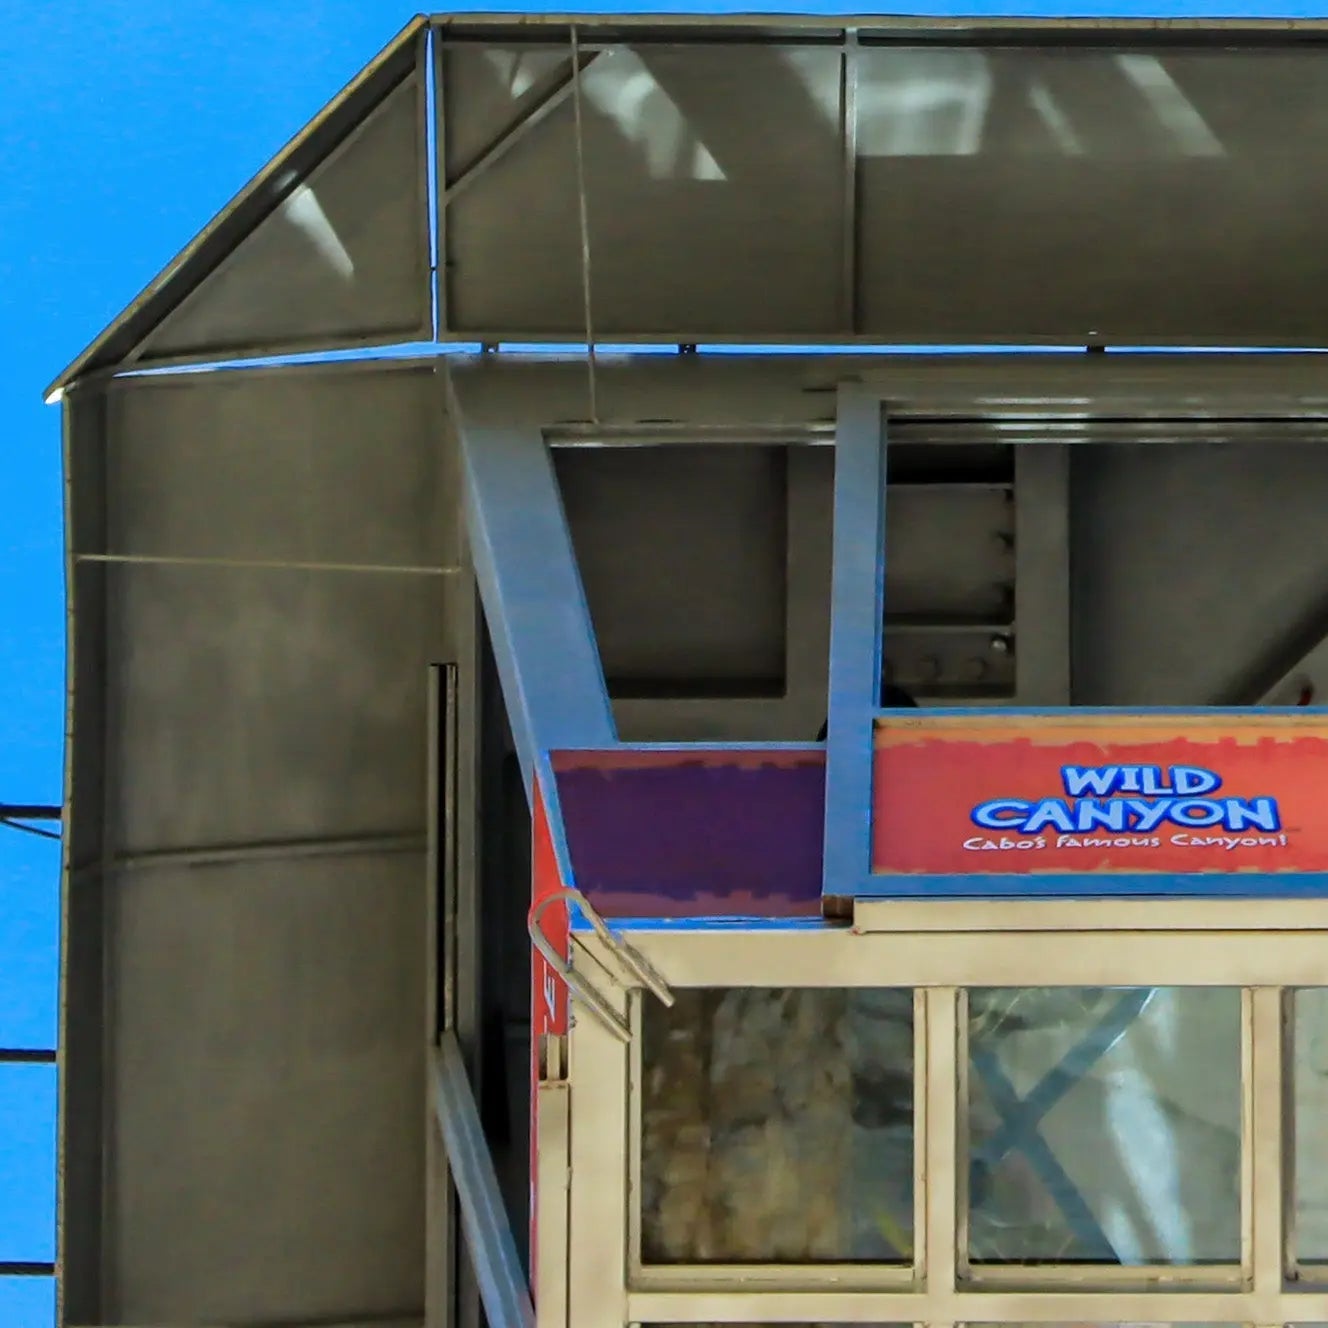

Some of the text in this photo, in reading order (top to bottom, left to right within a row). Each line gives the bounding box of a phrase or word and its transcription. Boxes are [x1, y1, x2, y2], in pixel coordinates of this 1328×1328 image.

[1060, 764, 1222, 798] WILD
[970, 796, 1281, 834] CANYON
[1170, 833, 1288, 851] Canyon!
